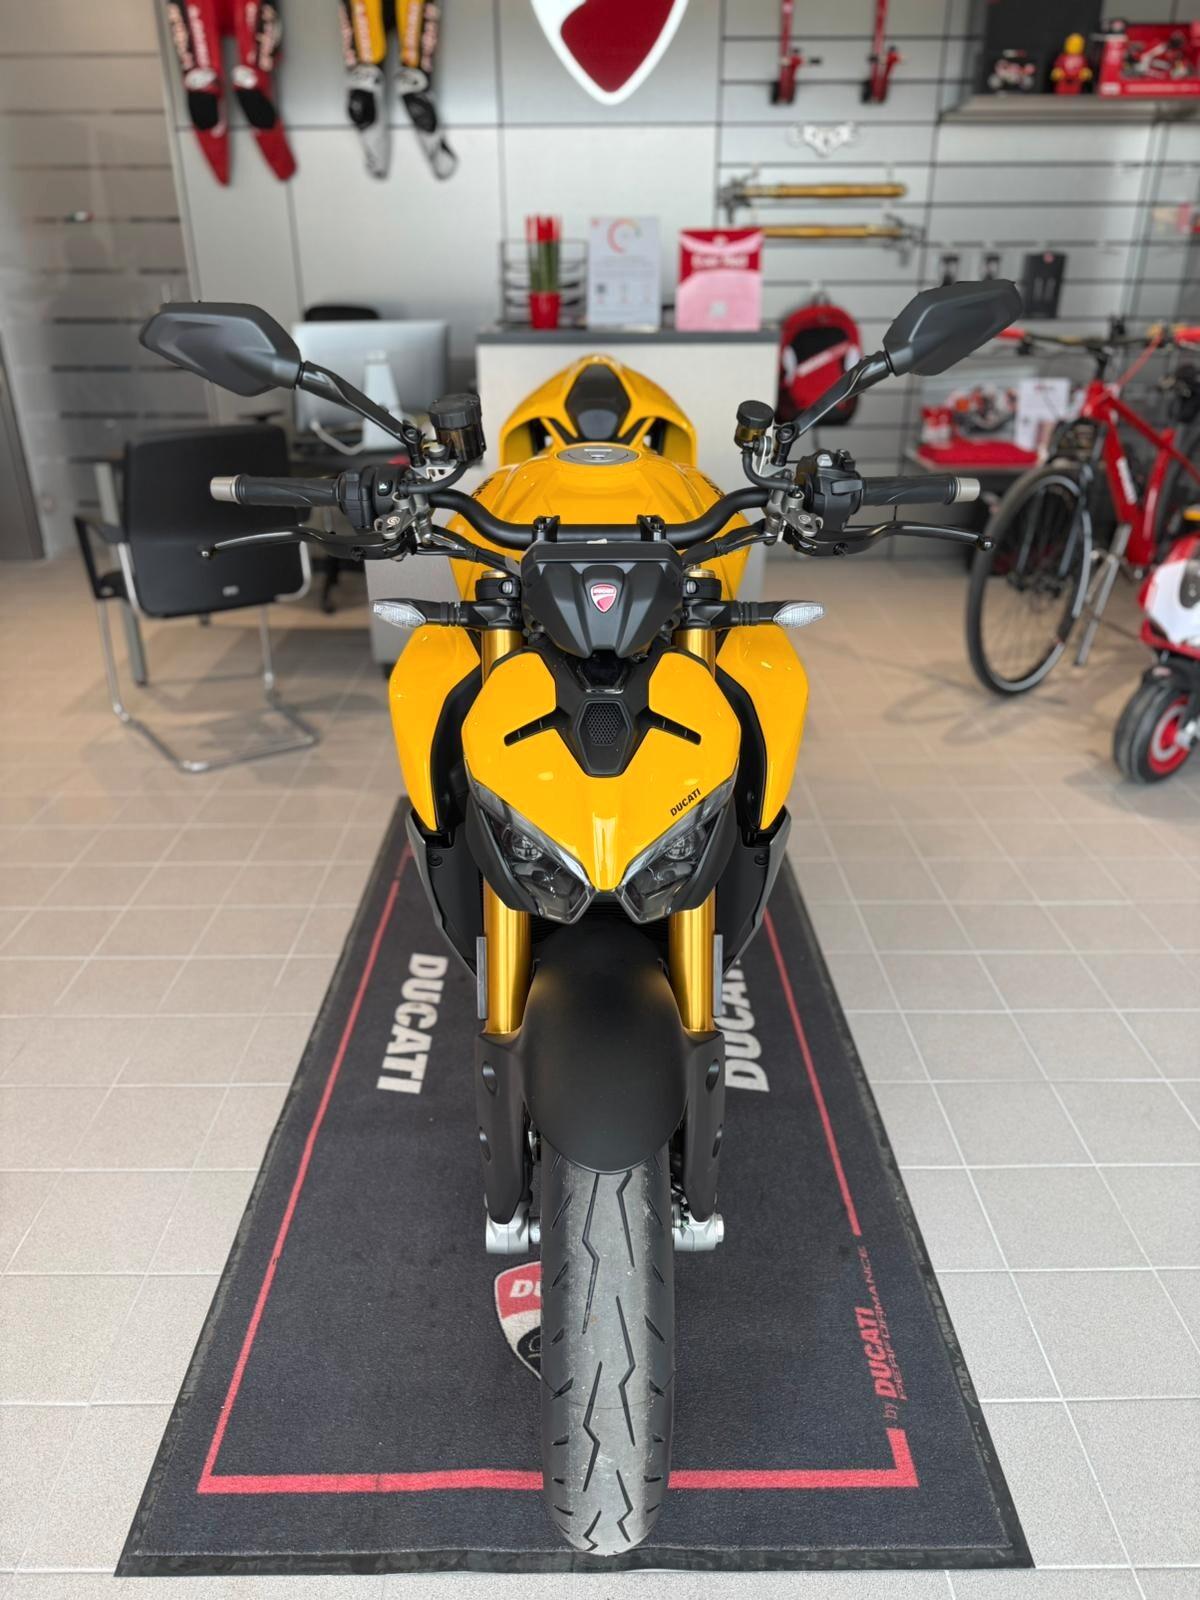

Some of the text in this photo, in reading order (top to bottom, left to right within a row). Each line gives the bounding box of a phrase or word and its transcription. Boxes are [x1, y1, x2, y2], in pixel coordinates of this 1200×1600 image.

[670, 788, 701, 816] DUCATI
[376, 953, 448, 1094] DUCATI
[854, 1307, 898, 1398] DUCATI
[858, 1245, 908, 1400] PERFORMANCE
